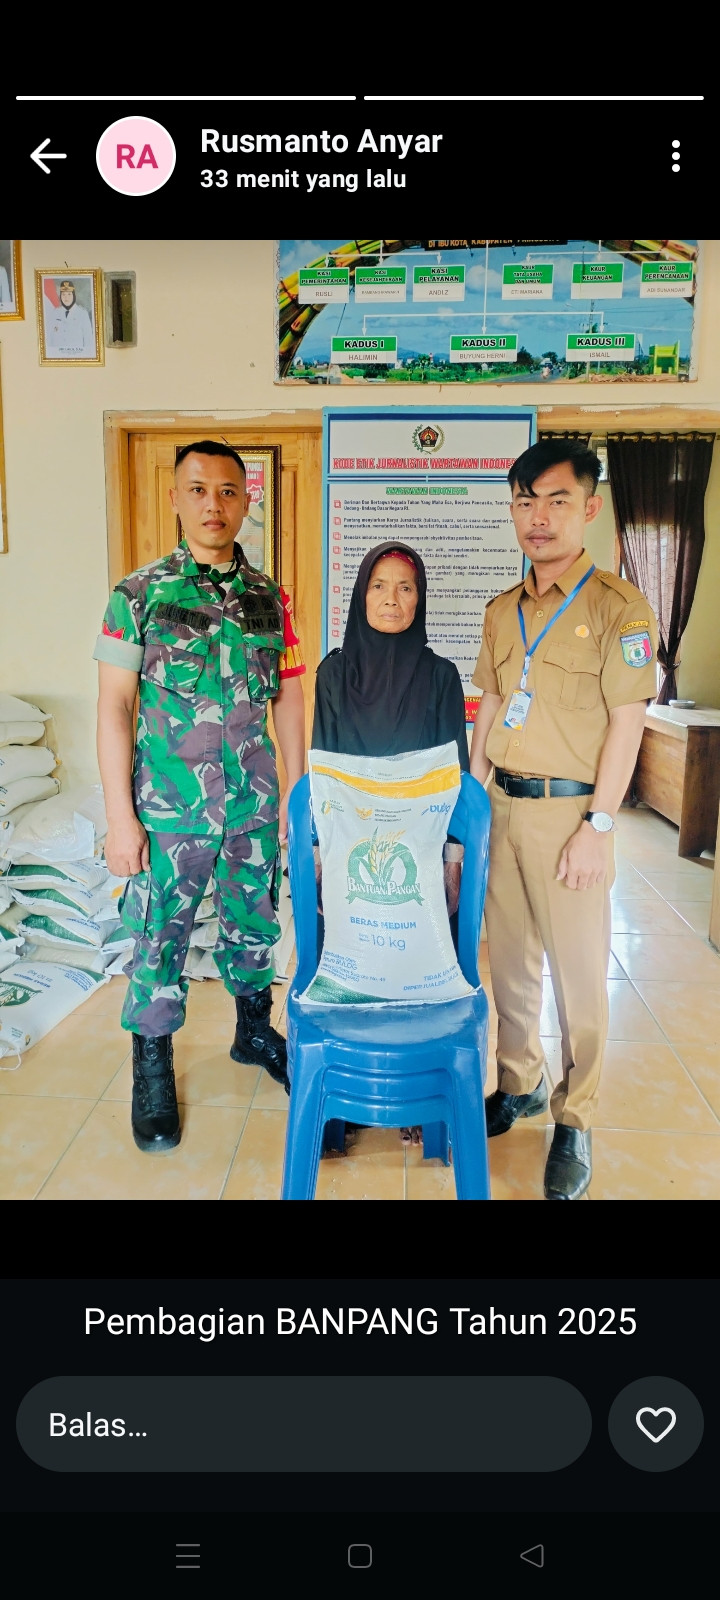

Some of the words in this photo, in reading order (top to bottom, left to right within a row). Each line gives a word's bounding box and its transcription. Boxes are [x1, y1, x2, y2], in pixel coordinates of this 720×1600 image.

[344, 339, 377, 349] KADUS
[380, 339, 384, 348] I
[461, 338, 496, 348] KADUS
[498, 338, 506, 347] II
[577, 337, 612, 347] KADUS
[615, 337, 625, 346] III
[333, 458, 355, 469] KODE
[356, 458, 375, 469] ETIK
[376, 458, 429, 469] JURNALISTIK
[430, 458, 479, 469] WARTAWAN
[350, 916, 378, 928] BERAS
[381, 921, 417, 930] MEDIUM
[371, 934, 385, 947] 10
[389, 936, 406, 951] kg
[424, 972, 442, 981] TIDAK
